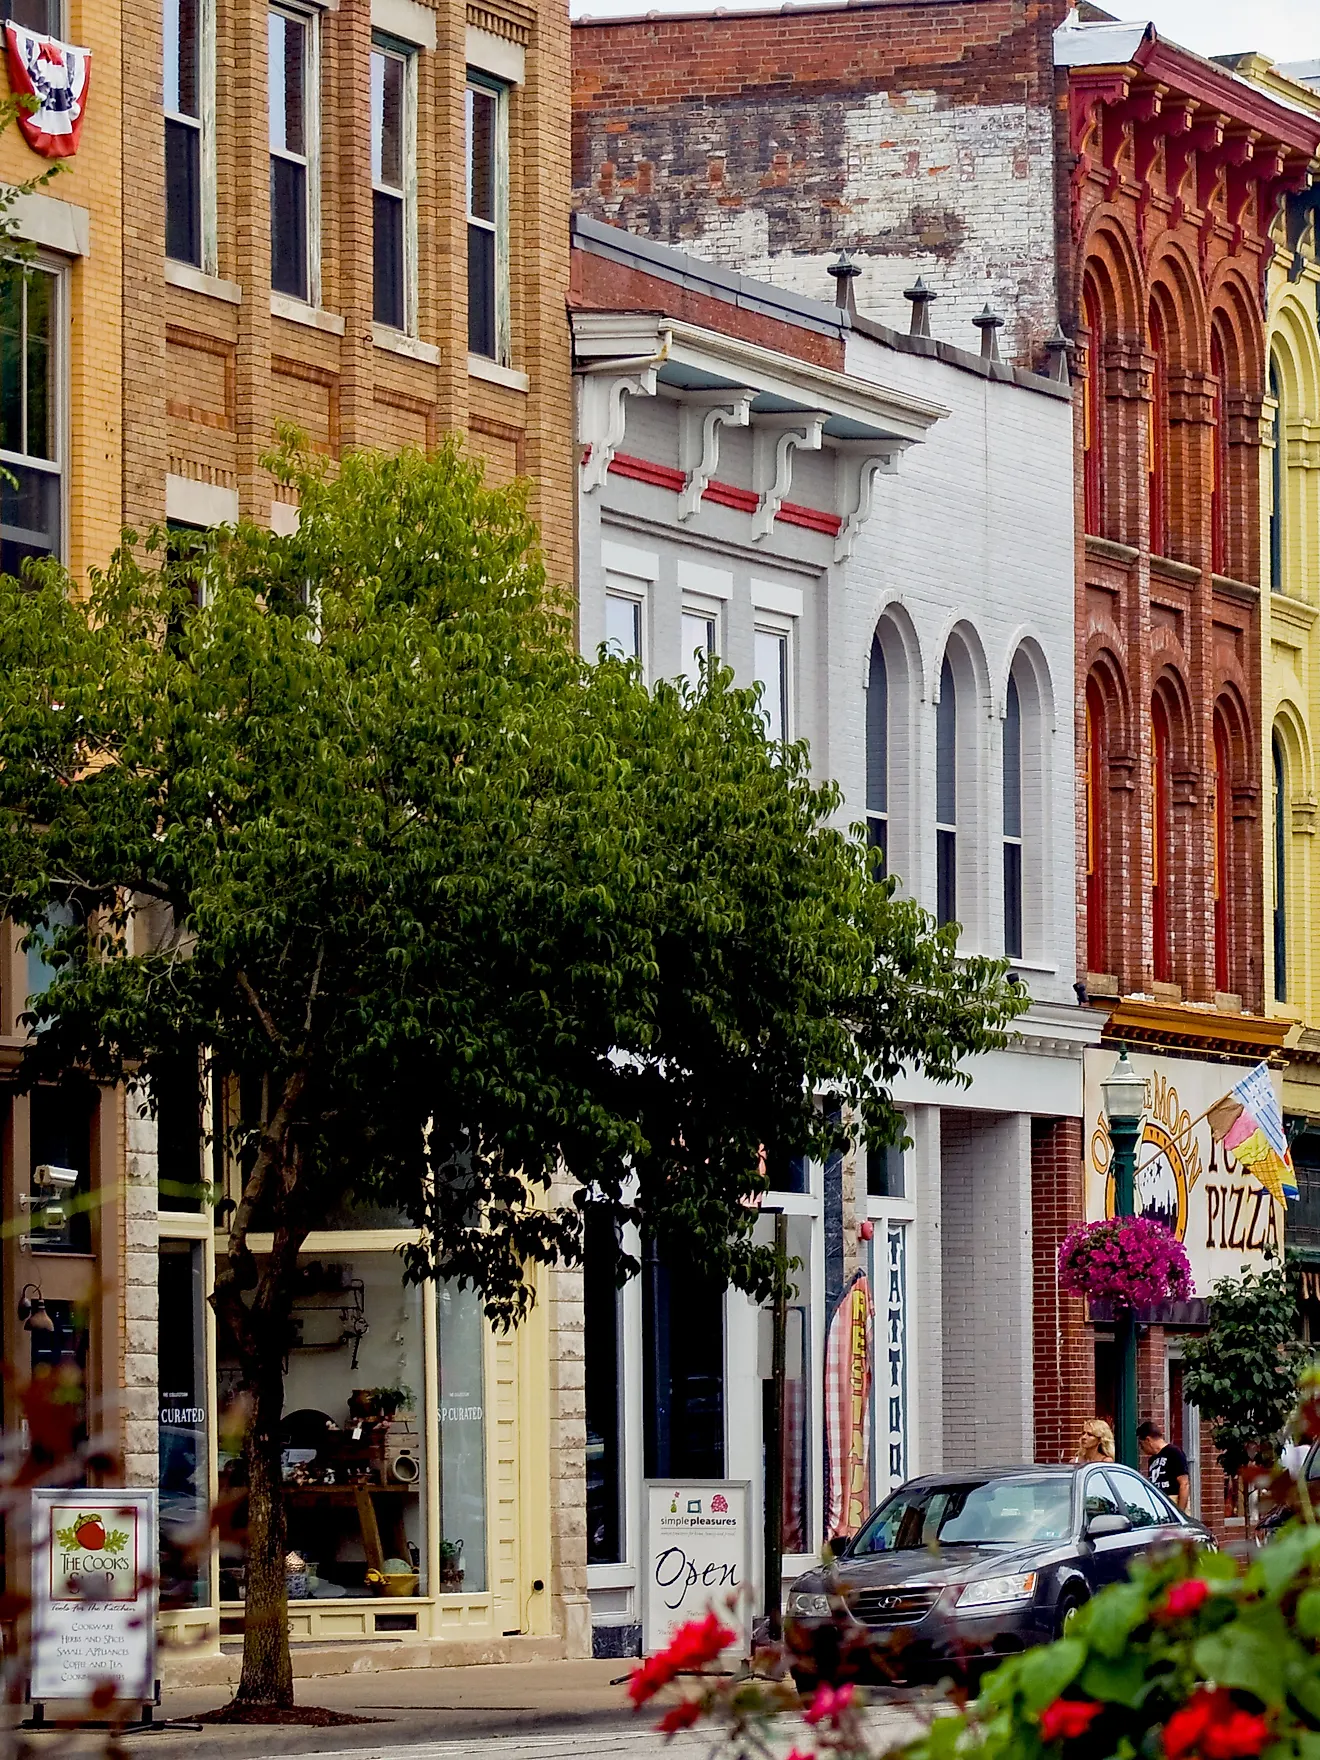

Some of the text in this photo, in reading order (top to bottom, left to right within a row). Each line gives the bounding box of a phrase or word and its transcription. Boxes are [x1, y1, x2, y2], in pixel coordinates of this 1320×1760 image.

[1153, 1070, 1203, 1194] MOON
[1205, 1183, 1279, 1252] PIZZA
[161, 1408, 205, 1423] CURATED
[448, 1406, 483, 1421] CURATED
[60, 1553, 129, 1574] THE COOK'S
[69, 1571, 115, 1594] SP
[655, 1546, 740, 1609] Open
